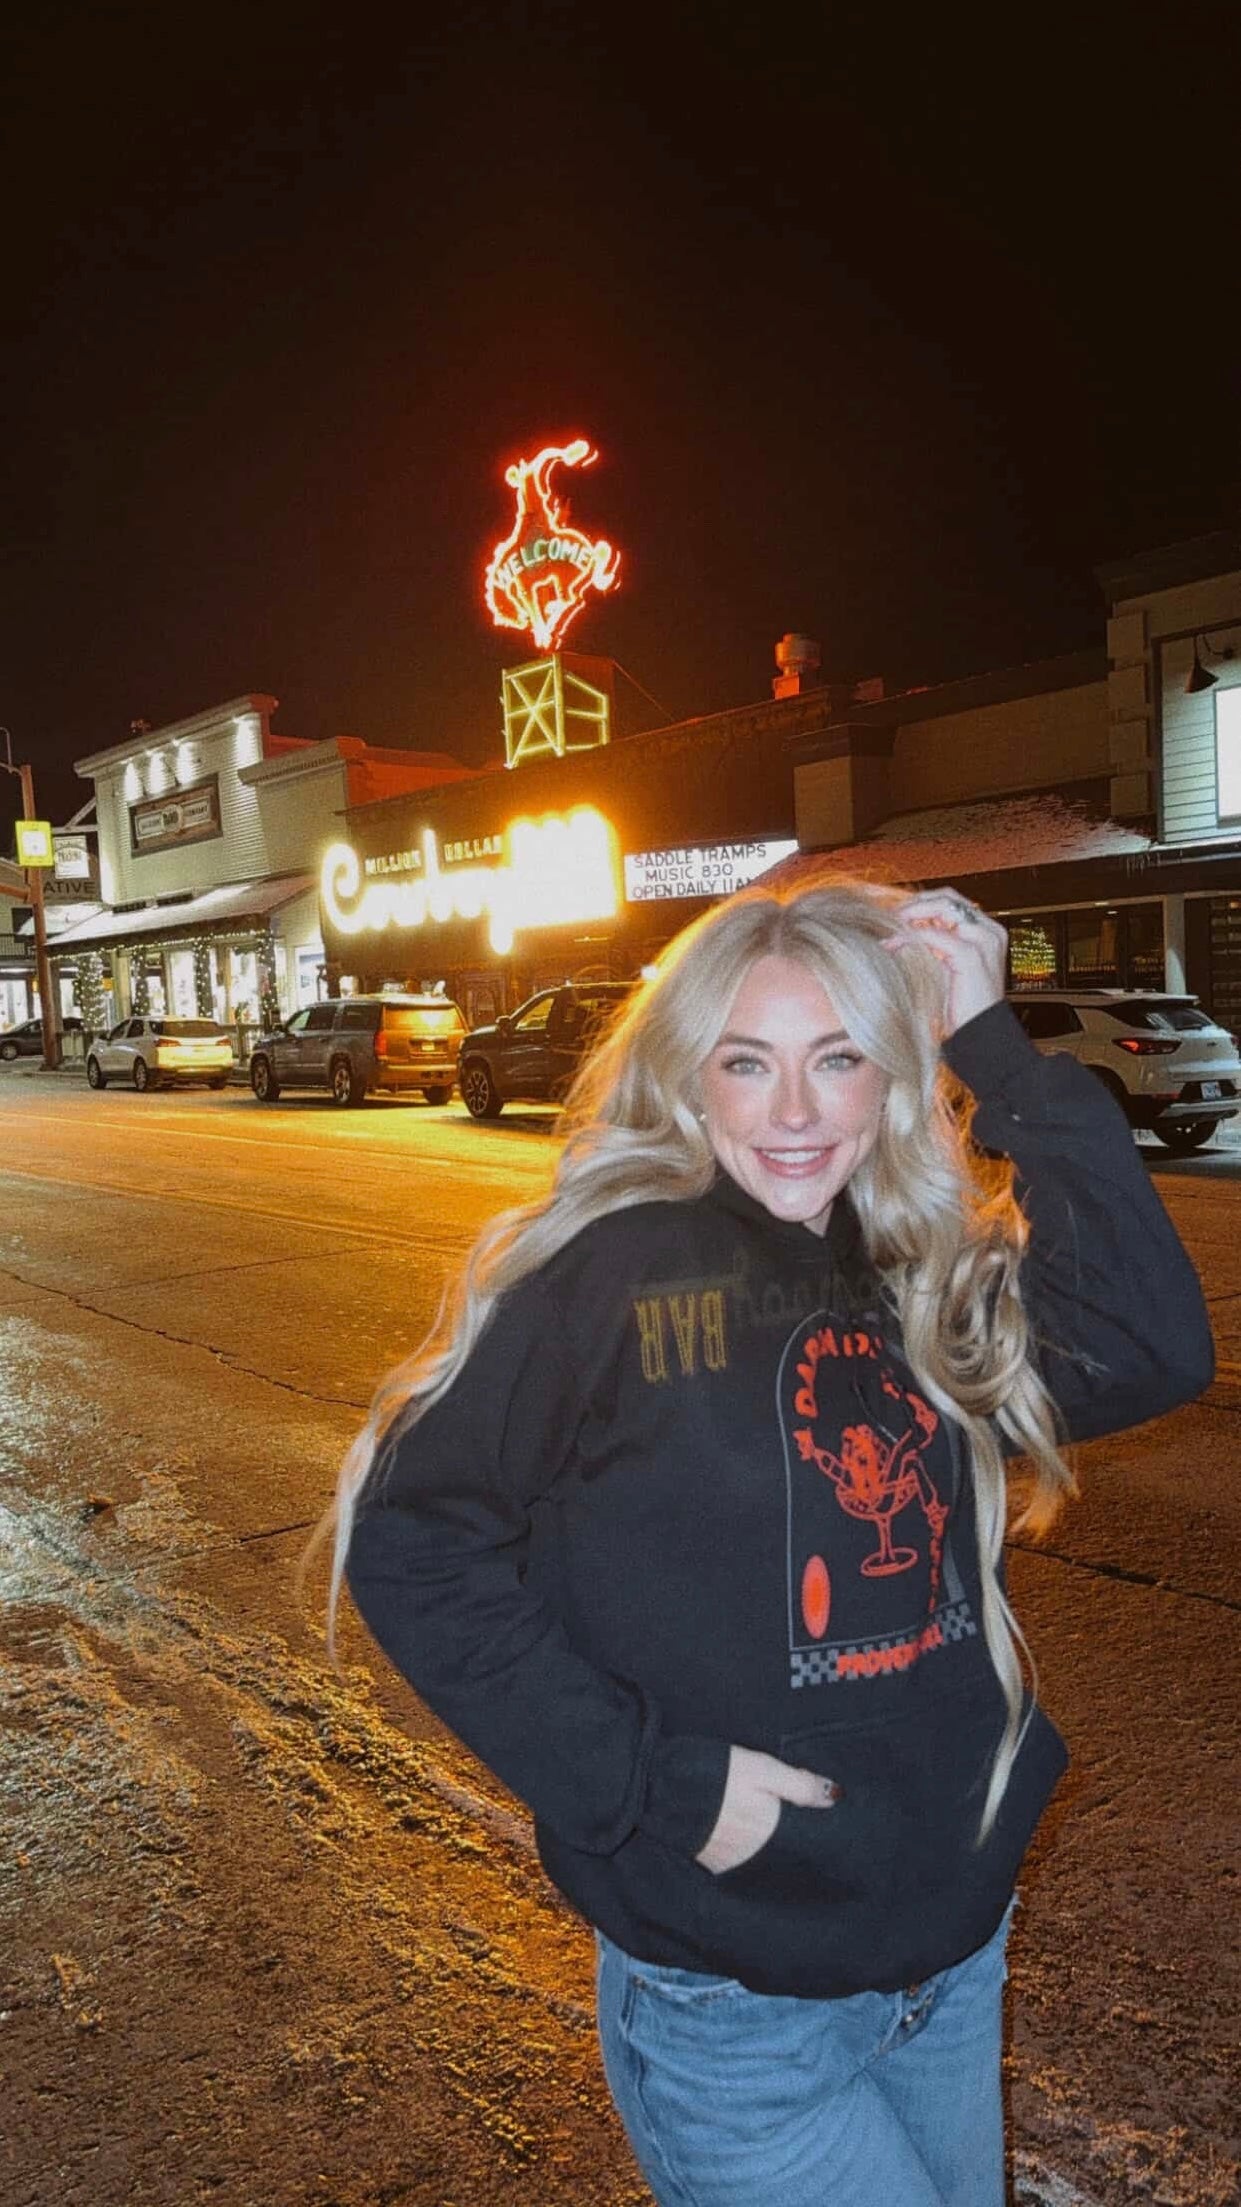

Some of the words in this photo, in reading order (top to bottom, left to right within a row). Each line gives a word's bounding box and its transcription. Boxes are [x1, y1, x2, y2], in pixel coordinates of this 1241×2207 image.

[494, 537, 591, 591] WELCOME
[364, 849, 422, 875] MILLION
[633, 850, 694, 869] SADDLE
[701, 843, 767, 862] TRAMPS
[645, 865, 695, 882] MUSIC
[702, 862, 734, 878] 830
[631, 883, 673, 899] OPEN
[677, 879, 718, 896] DAILY
